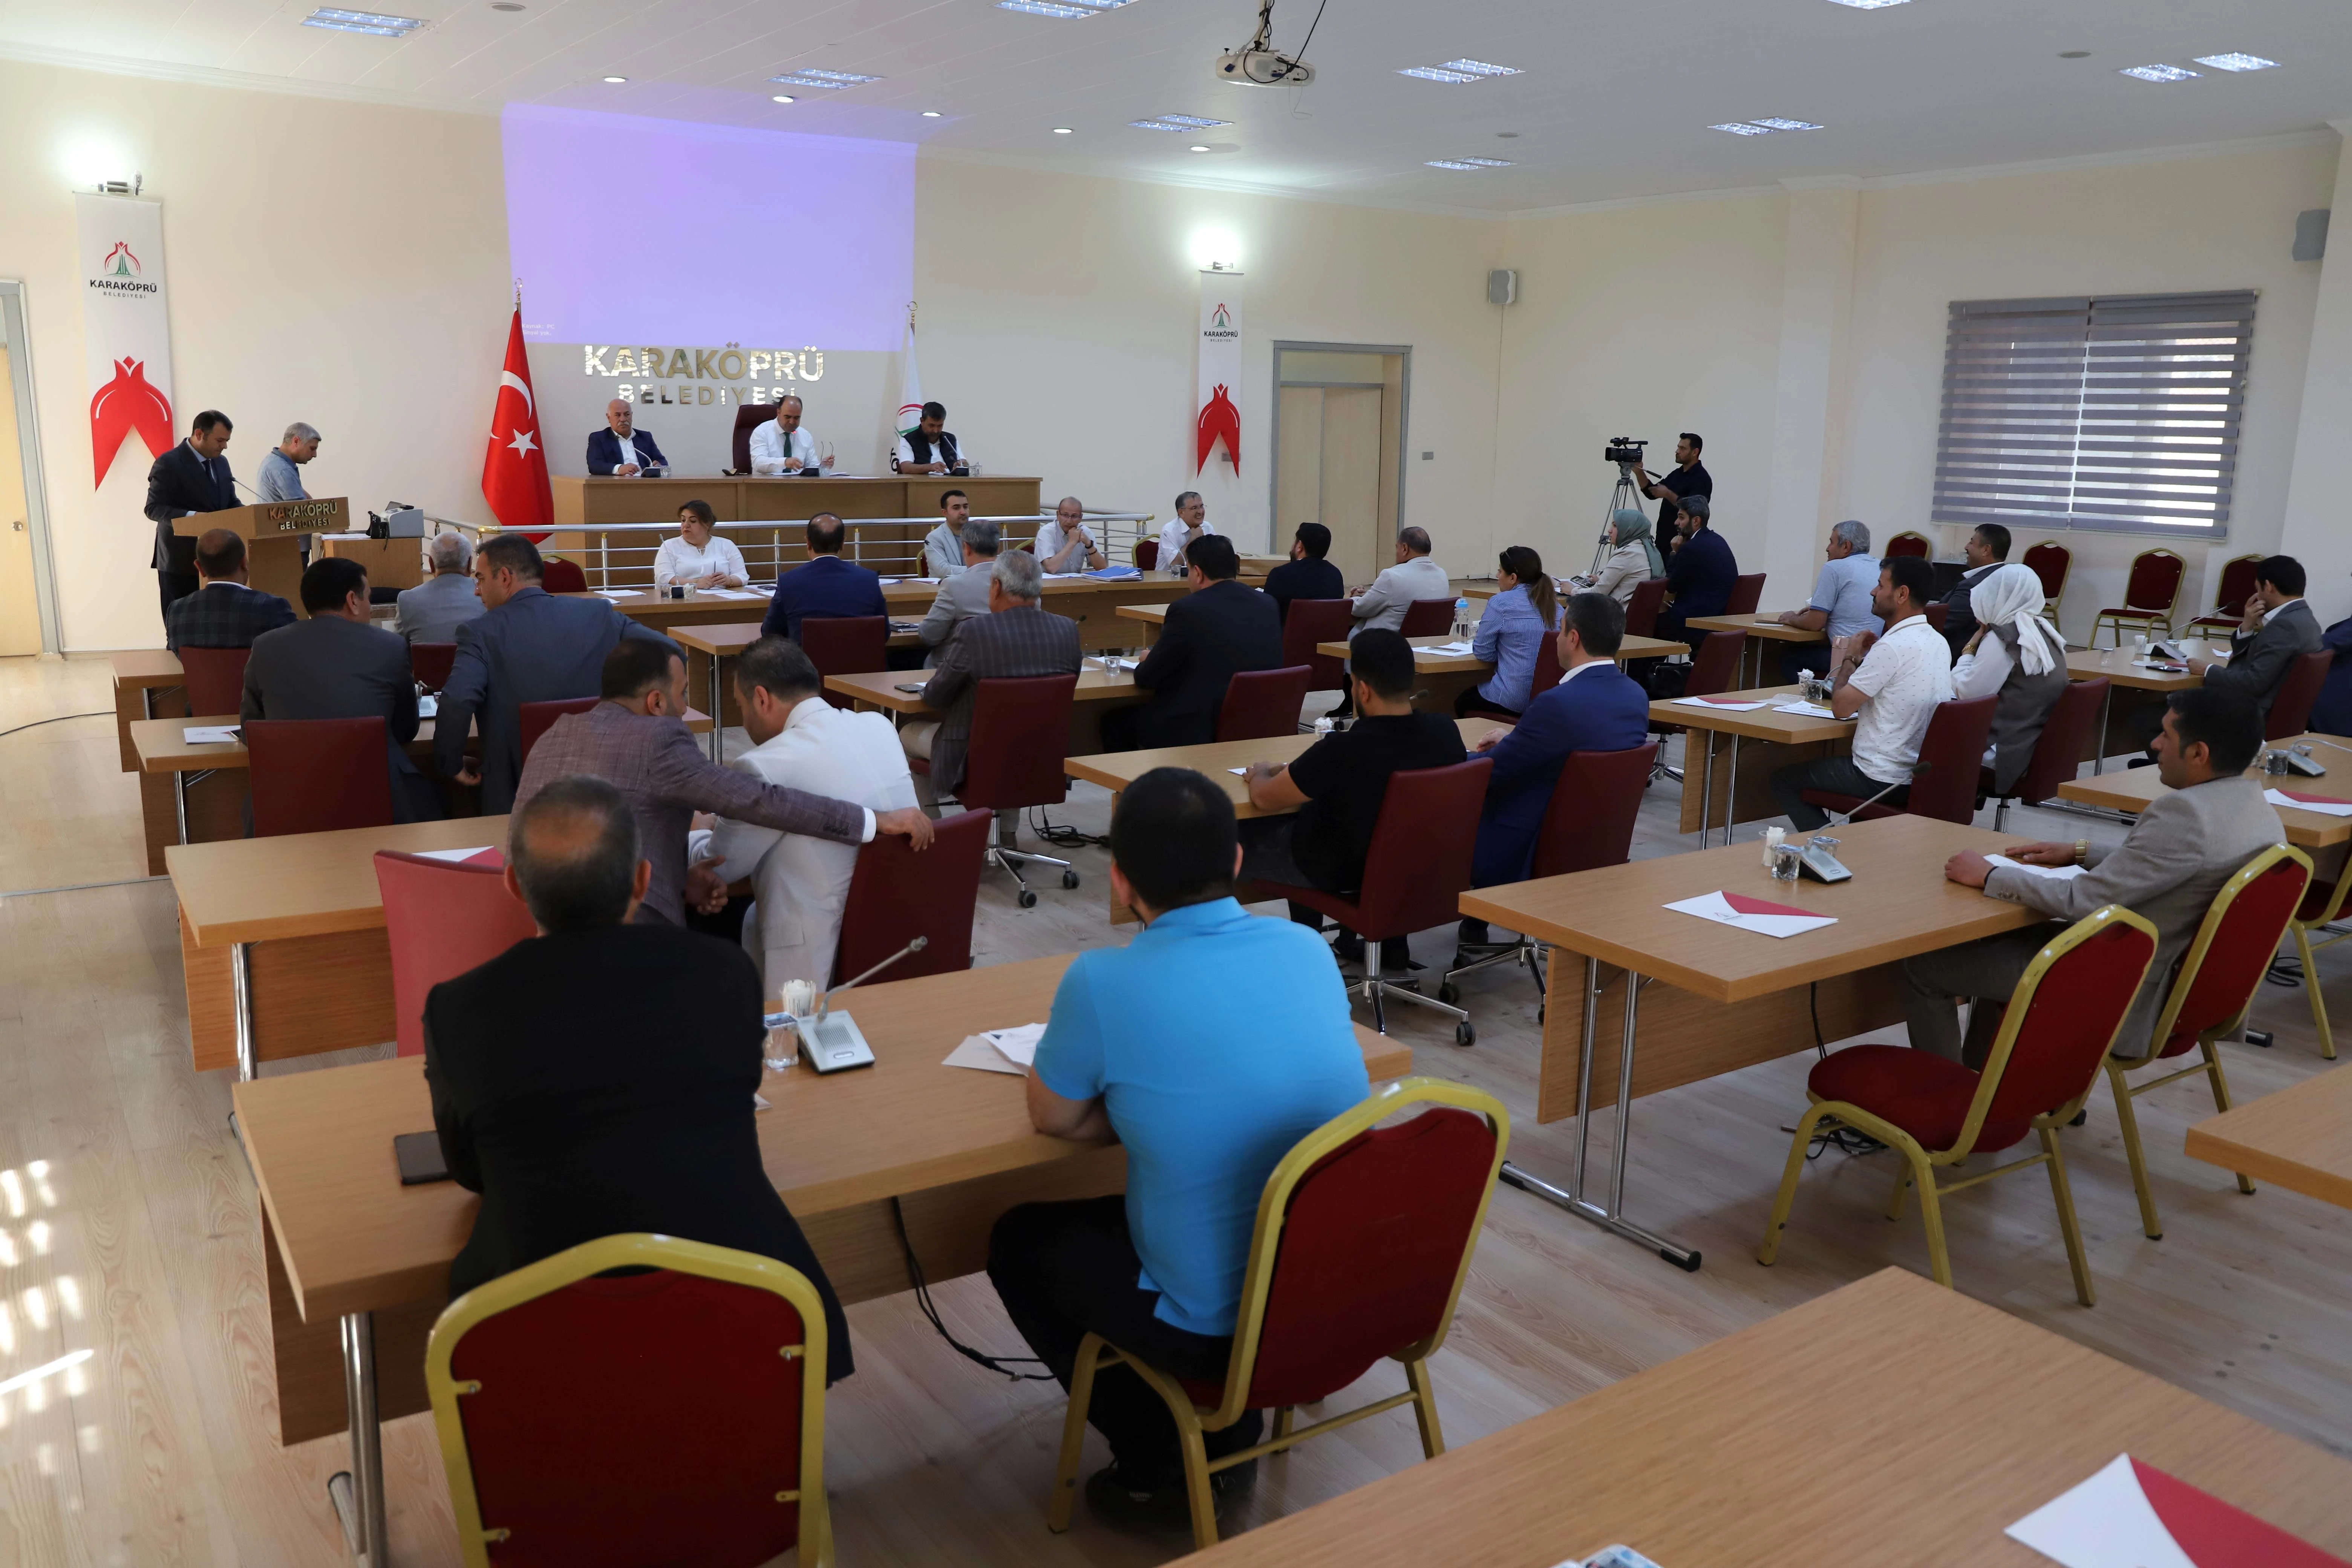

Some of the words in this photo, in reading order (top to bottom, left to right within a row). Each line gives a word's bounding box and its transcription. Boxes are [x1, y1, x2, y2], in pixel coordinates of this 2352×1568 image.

[90, 279, 157, 292] KARAKÖPRÜ
[585, 341, 823, 381] KARAKÖPRÜ
[269, 499, 337, 520] KARAKÖPRÜ
